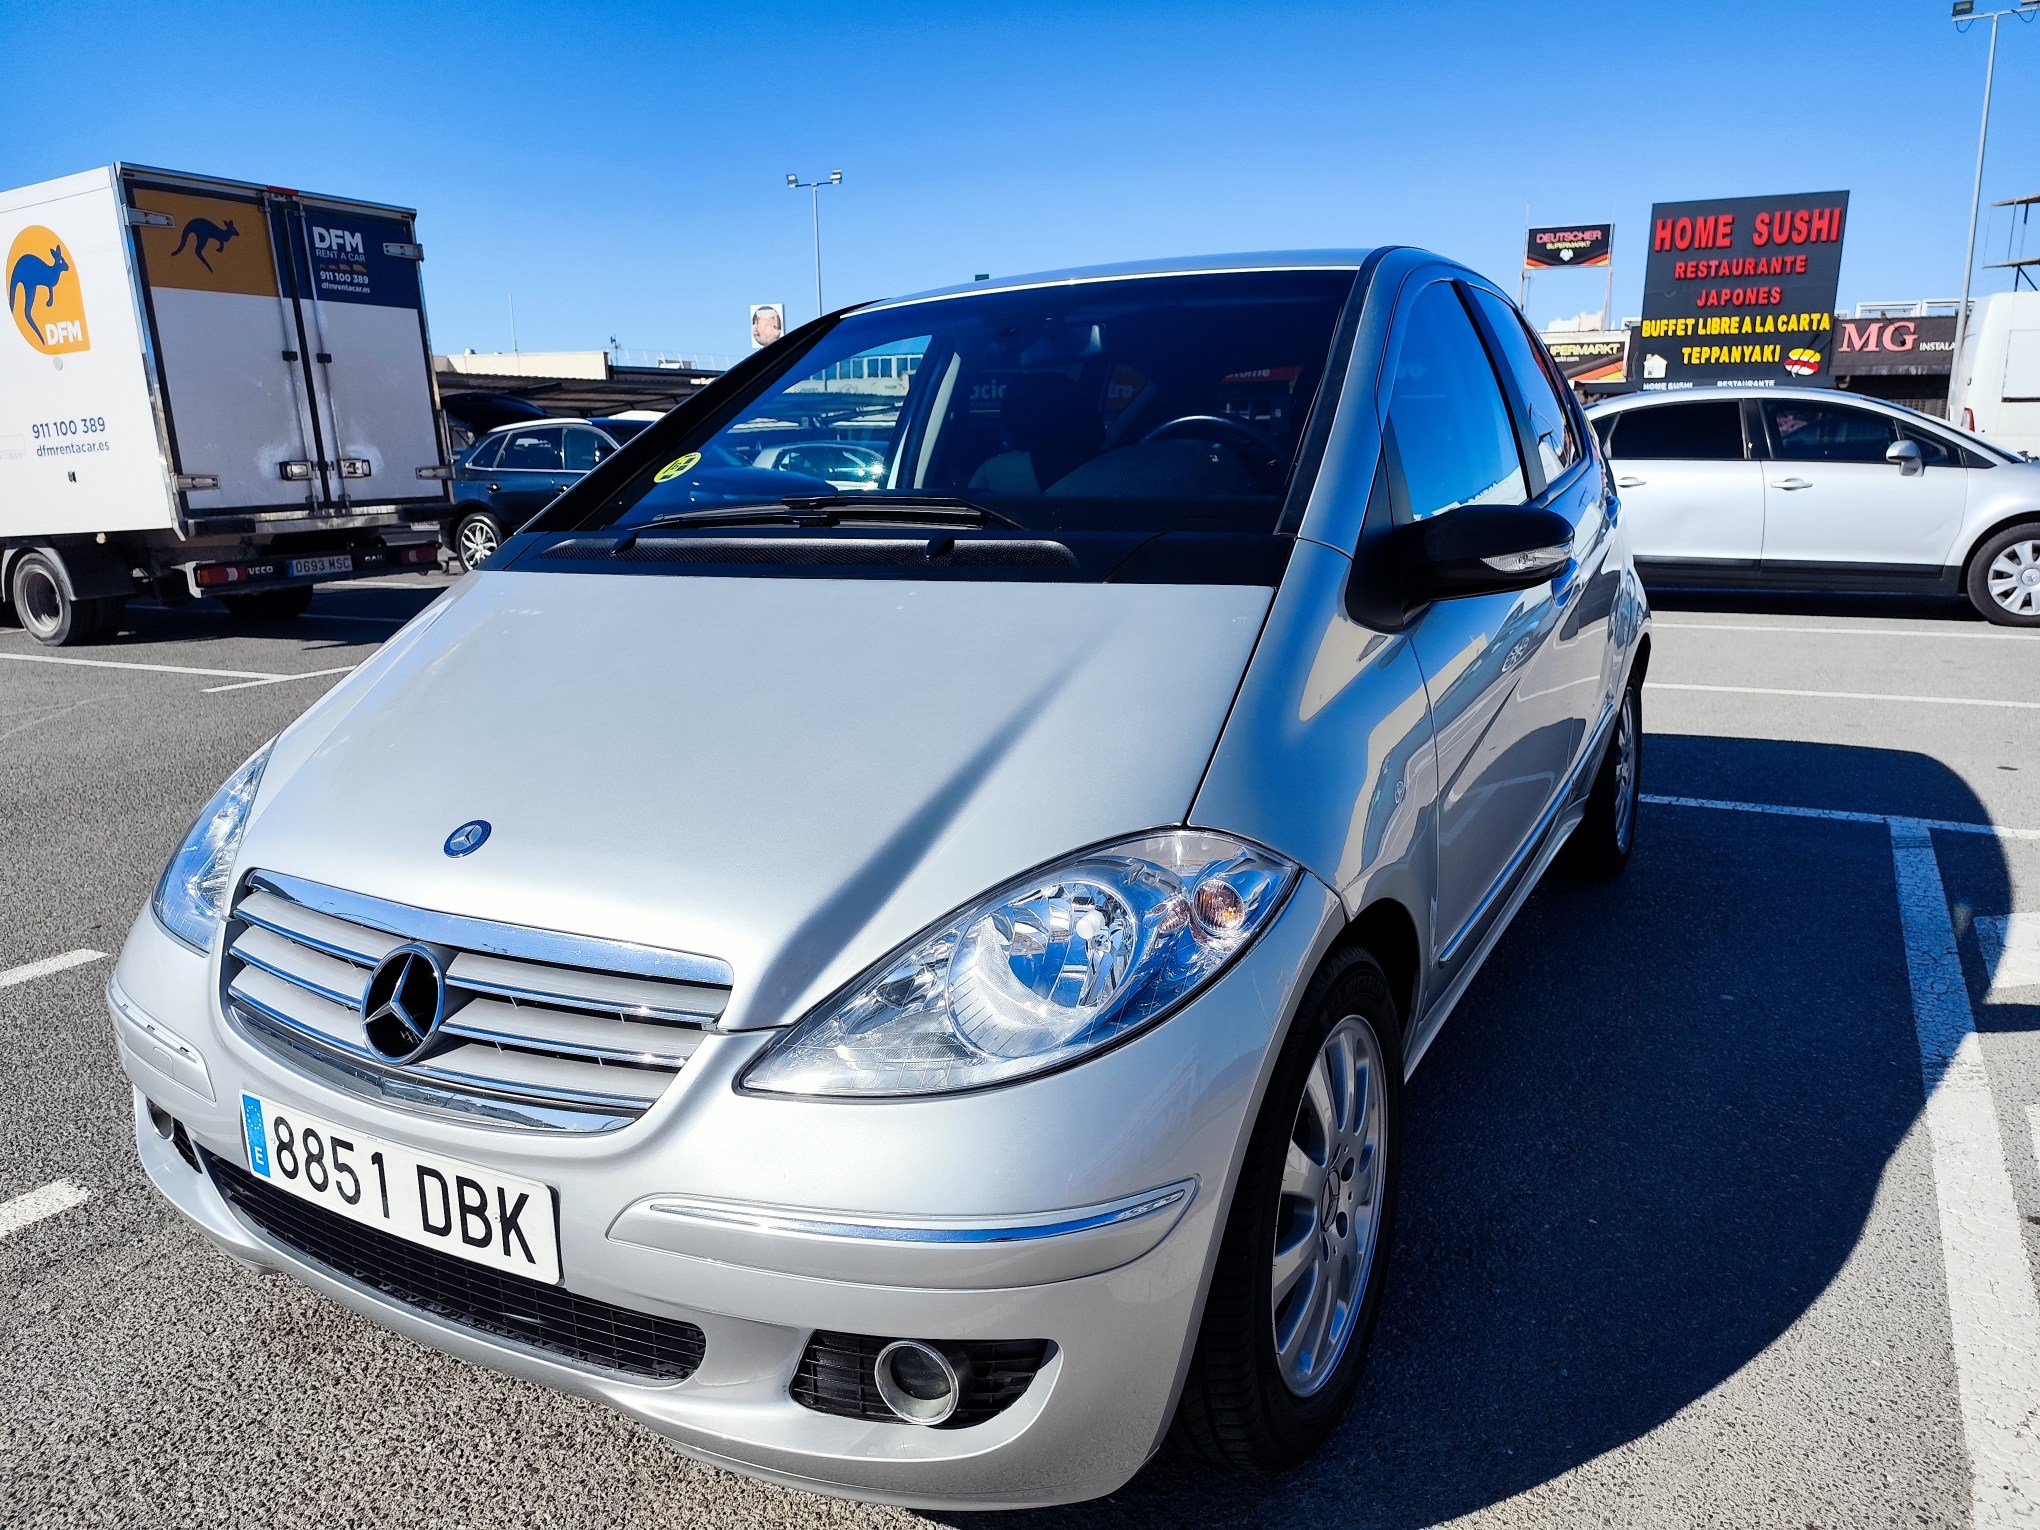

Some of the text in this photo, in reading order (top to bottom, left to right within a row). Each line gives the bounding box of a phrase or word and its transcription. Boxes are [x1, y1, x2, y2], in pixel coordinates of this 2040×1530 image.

[312, 226, 364, 254] DFM
[1536, 229, 1602, 244] DEUTSCHER
[1654, 207, 1841, 252] HOME SUSHI
[315, 249, 366, 262] RENT A CAR
[1546, 240, 1592, 250] SUPERMARKT
[320, 271, 369, 284] 911 100 389
[1674, 255, 1808, 280] RESTAURANTE
[321, 282, 371, 293] dfmrentacar.es
[1696, 286, 1782, 308] JAPONES
[45, 319, 83, 346] DFM
[1642, 312, 1831, 338] BUFFET LIBRE A LA CARTA
[1838, 321, 1919, 352] MG
[1681, 344, 1781, 365] TEPPANYAKI
[1643, 382, 1667, 391] HOME
[32, 416, 106, 439] 911 100 389
[36, 440, 110, 457] dfmrentacar.es
[248, 565, 274, 575] VECO
[295, 557, 350, 573] 0693 MSC
[254, 1145, 265, 1166] E
[273, 1116, 537, 1265] 8851 DBK
